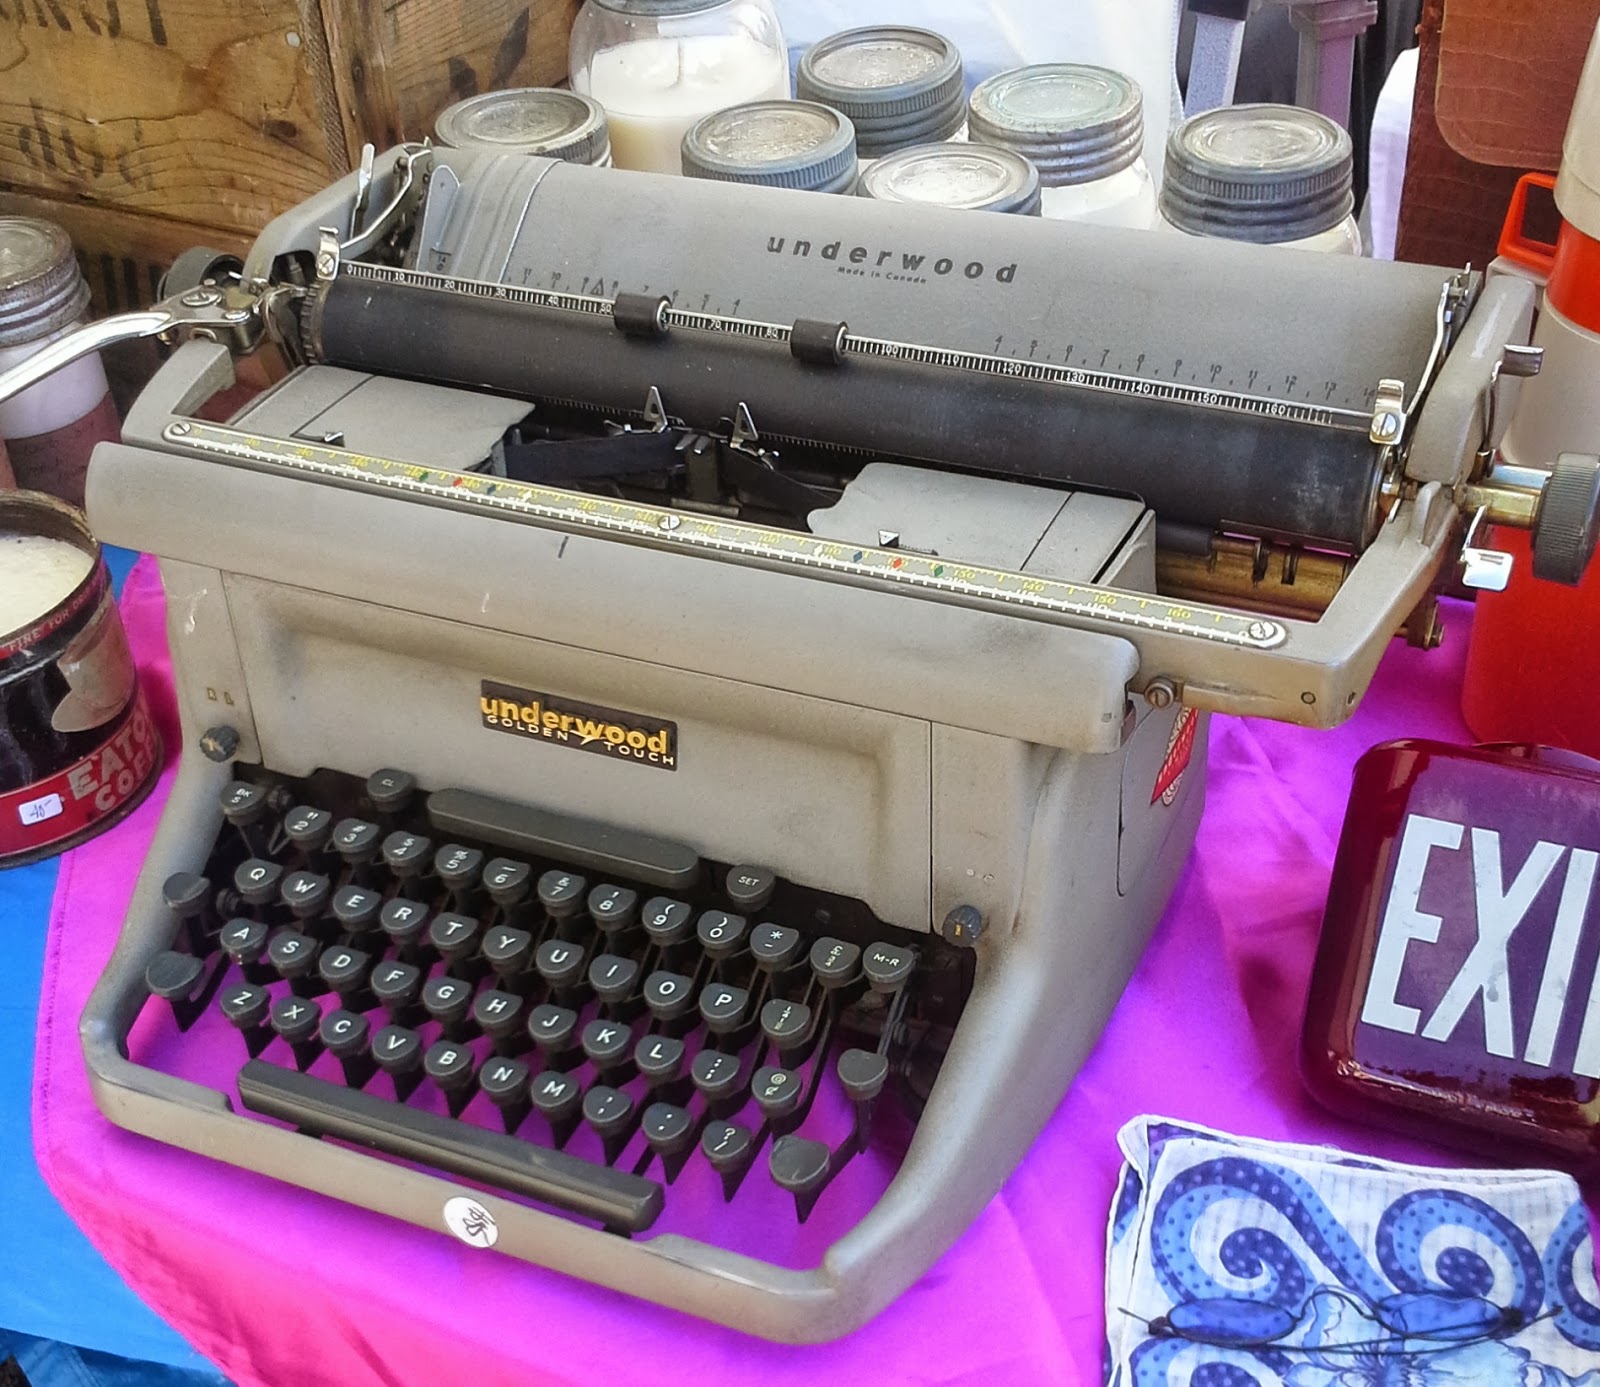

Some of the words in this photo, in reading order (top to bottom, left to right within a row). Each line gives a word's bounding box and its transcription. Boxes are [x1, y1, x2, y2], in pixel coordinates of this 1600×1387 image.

[767, 236, 1018, 283] underwood
[837, 266, 865, 277] Made
[871, 270, 881, 278] in
[885, 272, 927, 284] Canada
[395, 273, 405, 282] 10
[444, 280, 455, 289] 20
[495, 288, 507, 297] 30
[1003, 362, 1022, 374] 120
[1067, 372, 1085, 383] 130
[1132, 382, 1150, 393] 140
[1197, 392, 1218, 404] 150
[1266, 403, 1286, 415] 160
[480, 696, 667, 754] underwood
[487, 715, 570, 741] GOLDEN
[604, 741, 674, 766] TOUCH
[292, 820, 308, 830] 2
[343, 833, 357, 842] 3
[446, 860, 460, 869] 5
[495, 874, 508, 884] 6
[551, 887, 564, 896] 7
[600, 900, 613, 910] 8
[652, 914, 667, 925] 9
[738, 875, 759, 887] SET
[250, 868, 266, 881] Q
[295, 879, 316, 893] W
[347, 894, 365, 908] E
[395, 907, 412, 920] R
[446, 921, 463, 936] T
[499, 935, 517, 949] Y
[550, 949, 569, 963] U
[659, 981, 676, 995] O
[714, 994, 732, 1007] P
[1361, 813, 1600, 1079] EXI
[232, 991, 253, 1005] Z
[283, 1005, 305, 1020] X
[335, 1020, 352, 1033] C
[388, 1035, 407, 1050] V
[439, 1051, 457, 1065] B
[492, 1066, 514, 1081] N
[542, 1080, 566, 1097] M
[233, 926, 250, 940] A
[283, 940, 299, 954] S
[333, 954, 351, 968] D
[385, 969, 404, 982] F
[437, 985, 456, 999] G
[486, 998, 508, 1014] H
[541, 1014, 560, 1027] J
[596, 1028, 617, 1044] K
[649, 1043, 663, 1059] L
